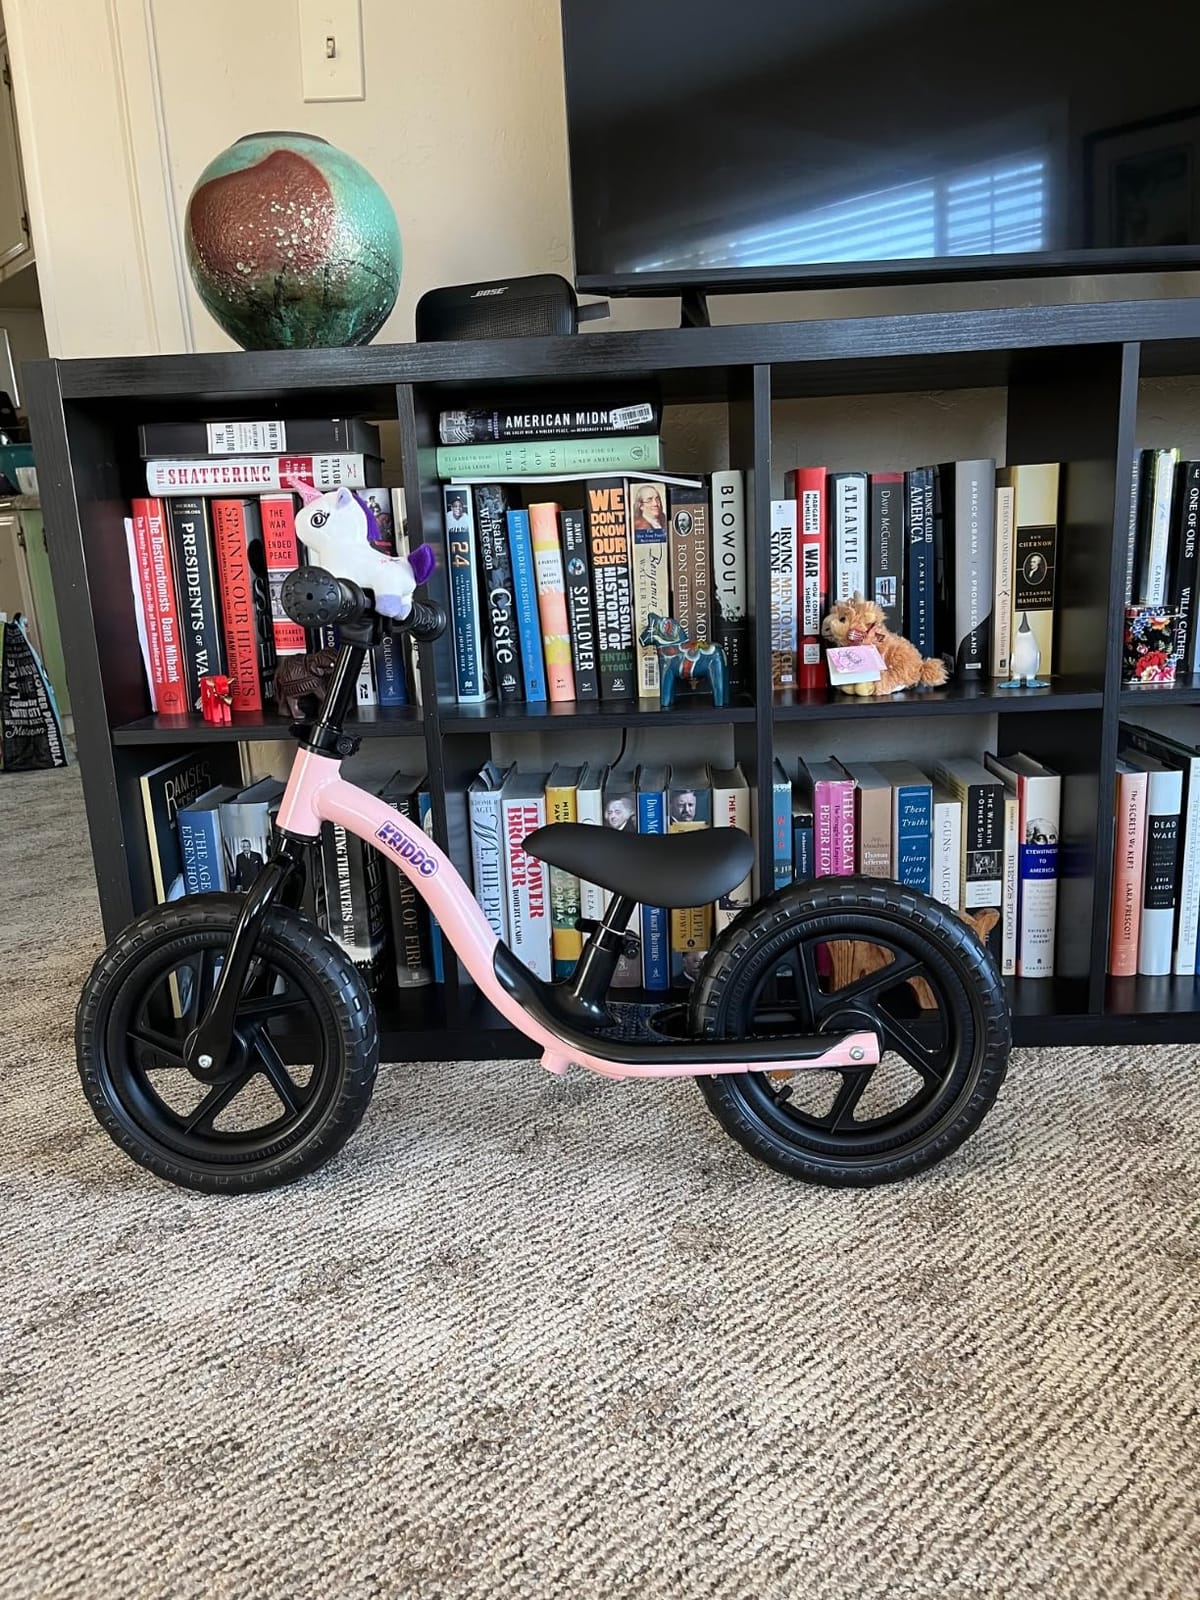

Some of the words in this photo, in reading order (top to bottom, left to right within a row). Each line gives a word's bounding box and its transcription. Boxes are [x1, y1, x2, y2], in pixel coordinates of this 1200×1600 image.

[470, 287, 509, 298] BOSE
[269, 423, 278, 438] BIRD
[504, 411, 571, 429] AMERICAN
[215, 431, 226, 445] THE
[226, 424, 236, 452] OUTLIER
[269, 438, 278, 451] KAI
[321, 457, 329, 485] KEVIN
[333, 457, 341, 485] BOYLE
[519, 448, 528, 472] FALL
[535, 453, 542, 466] OF
[156, 469, 165, 485] THE
[168, 466, 271, 486] SHATTERING
[270, 509, 284, 517] THE
[590, 487, 624, 512] WE
[881, 490, 891, 515] DAVID
[924, 491, 933, 516] DANCE
[970, 480, 978, 518] BARACK
[1189, 487, 1200, 512] ONE
[149, 515, 161, 537] The
[269, 519, 286, 529] WAR
[514, 516, 522, 541] RUTH
[590, 511, 625, 525] DON'T
[693, 506, 705, 536] THE
[844, 484, 857, 564] ATLANTIC
[910, 485, 925, 545] AMERICA
[1126, 483, 1137, 550] DICTIONARY
[1187, 513, 1198, 528] OF
[224, 506, 243, 558] SPAIN
[479, 507, 494, 570] Wilkerson
[492, 518, 506, 559] Isabel
[565, 517, 575, 551] QUAMMEN
[574, 523, 583, 544] DAVID
[591, 524, 625, 538] KNOW
[720, 485, 737, 595] BLOWOUT
[925, 516, 934, 544] CALLED
[970, 521, 978, 554] OBAMA
[1184, 529, 1197, 559] OURS
[268, 540, 292, 550] ENDED
[269, 551, 292, 561] PEACE
[450, 541, 471, 568] 24
[516, 543, 526, 573] BADER
[592, 537, 626, 554] OUR
[677, 543, 687, 571] RON
[770, 531, 782, 573] STONE
[780, 527, 793, 573] IRVING
[1018, 540, 1054, 549] CHERNOW
[229, 563, 246, 584] IN
[593, 554, 627, 566] SELVES
[616, 566, 625, 575] A
[694, 540, 706, 585] HOUSE
[804, 549, 819, 578] WAR
[152, 537, 171, 615] Destructionists
[181, 521, 205, 632] PRESIDENTS
[195, 633, 204, 648] OF
[594, 567, 605, 610] MODERN
[639, 558, 648, 602] WALTER
[771, 576, 782, 597] MY
[841, 571, 849, 599] SIMON
[1153, 565, 1162, 602] CANDICE
[520, 575, 531, 625] GINSBURG
[603, 566, 620, 634] HISTORY
[695, 589, 706, 608] OF
[780, 576, 793, 605] MEN
[970, 579, 978, 627] PROMISED
[1179, 587, 1191, 620] WILLA
[232, 585, 249, 625] OUR
[617, 578, 632, 650] PERSONAL
[780, 607, 793, 625] TO
[161, 617, 174, 643] Dana
[489, 587, 515, 665] Caste
[574, 585, 594, 671] SPILLOVER
[597, 611, 609, 651] IRELAND
[696, 612, 708, 643] MOR
[805, 616, 811, 626] US
[227, 629, 238, 650] ADAM
[465, 623, 473, 652] WILLIE
[608, 636, 621, 651] OF
[781, 628, 793, 673] MATCH
[1175, 620, 1188, 663] CATHER
[163, 645, 181, 684] Milbank
[236, 629, 256, 698] HEARTS
[468, 653, 476, 676] MAYS
[7, 658, 20, 700] LAKE
[32, 674, 48, 710] LOWER
[42, 711, 63, 767] PENINSULA
[646, 798, 657, 815] DAVID
[728, 795, 737, 814] THE
[904, 805, 926, 815] These
[977, 798, 985, 825] OTHER
[987, 792, 995, 809] THE
[820, 804, 831, 846] PETER
[902, 818, 928, 828] Truths
[985, 811, 994, 846] WARMTH
[1127, 801, 1138, 838] SECRETS
[1153, 821, 1177, 830] DEAD
[194, 828, 208, 860] THE
[507, 807, 527, 888] BROKER
[842, 822, 855, 872] GREAT
[942, 820, 952, 853] GUNS
[976, 826, 985, 849] SUNS
[1128, 838, 1136, 850] We
[1152, 831, 1177, 841] WAKE
[181, 825, 200, 895] EISENHOW
[376, 824, 437, 877] KRIDDO
[863, 850, 888, 859] Thomas
[863, 858, 889, 867] Jefferson
[902, 855, 927, 864] History
[1126, 850, 1135, 870] KEPT
[199, 863, 211, 890] AGE
[338, 854, 350, 879] THE
[481, 859, 499, 892] THE
[906, 867, 913, 876] of
[914, 866, 924, 874] the
[903, 877, 926, 886] United
[1125, 882, 1133, 903] LARA
[1150, 884, 1173, 892] LARSON
[341, 878, 354, 921] WATERS
[512, 888, 521, 918] ROBERT
[402, 907, 417, 930] OF
[1006, 903, 1014, 940] FLOOD
[1122, 905, 1133, 942] PRESCOTT
[514, 924, 523, 945] CARO
[649, 933, 660, 962] BROTHERS
[404, 935, 421, 972] FIRE
